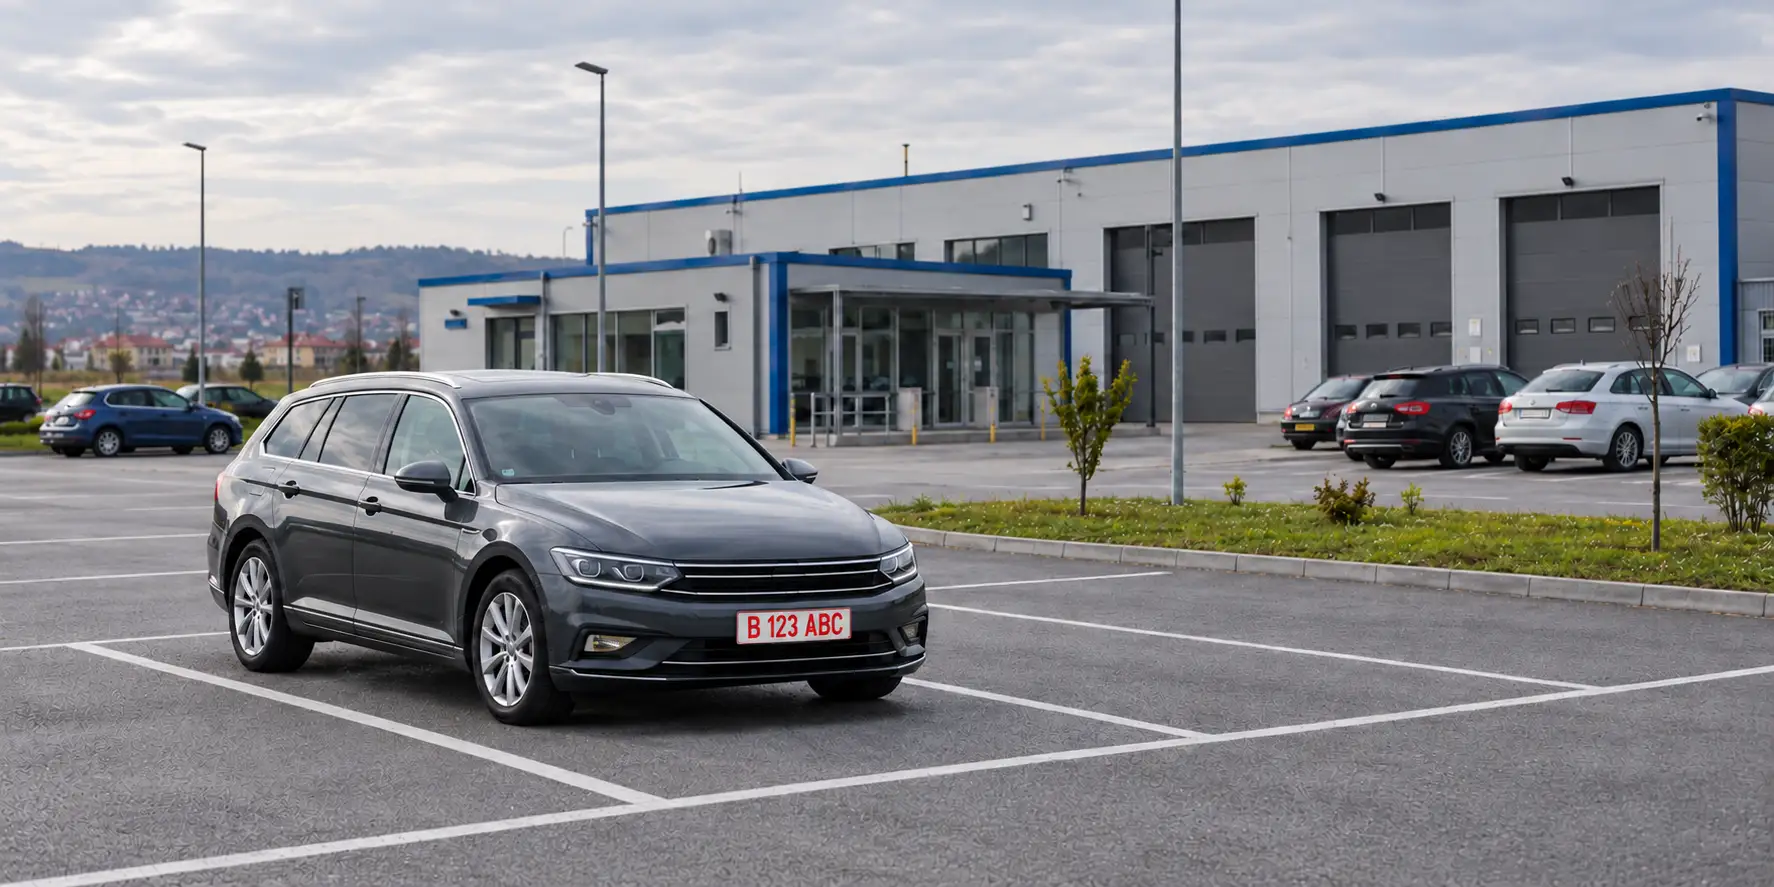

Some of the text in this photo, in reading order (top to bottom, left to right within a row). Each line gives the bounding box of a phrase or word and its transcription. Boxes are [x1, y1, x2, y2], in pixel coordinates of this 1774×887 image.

[748, 612, 843, 639] B 123 ABC
